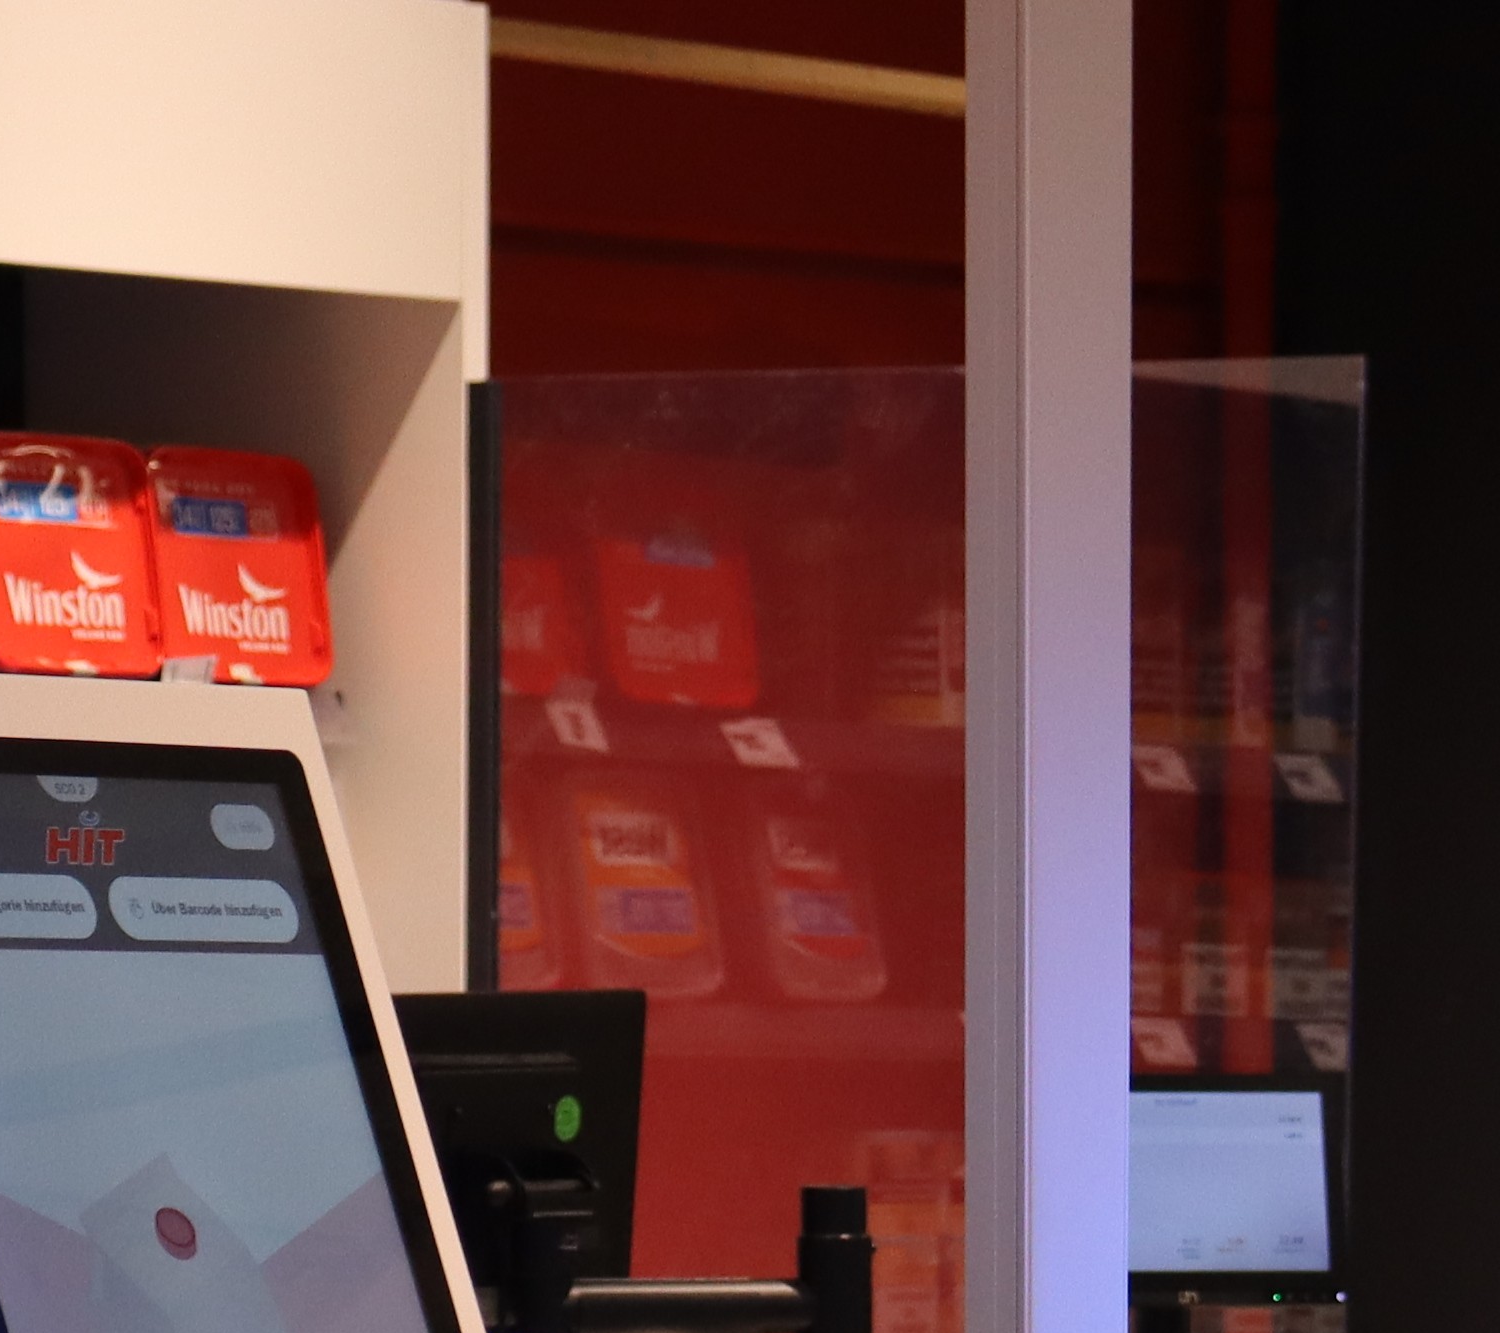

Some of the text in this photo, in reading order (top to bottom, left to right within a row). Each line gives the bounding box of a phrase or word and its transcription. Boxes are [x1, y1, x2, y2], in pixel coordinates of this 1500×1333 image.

[4, 571, 127, 629] Winston
[177, 583, 291, 640] Winston
[46, 811, 125, 865] HIT
[24, 899, 85, 914] hinzufügen
[179, 903, 222, 917] Barcode
[224, 904, 282, 919] hinzufügen
